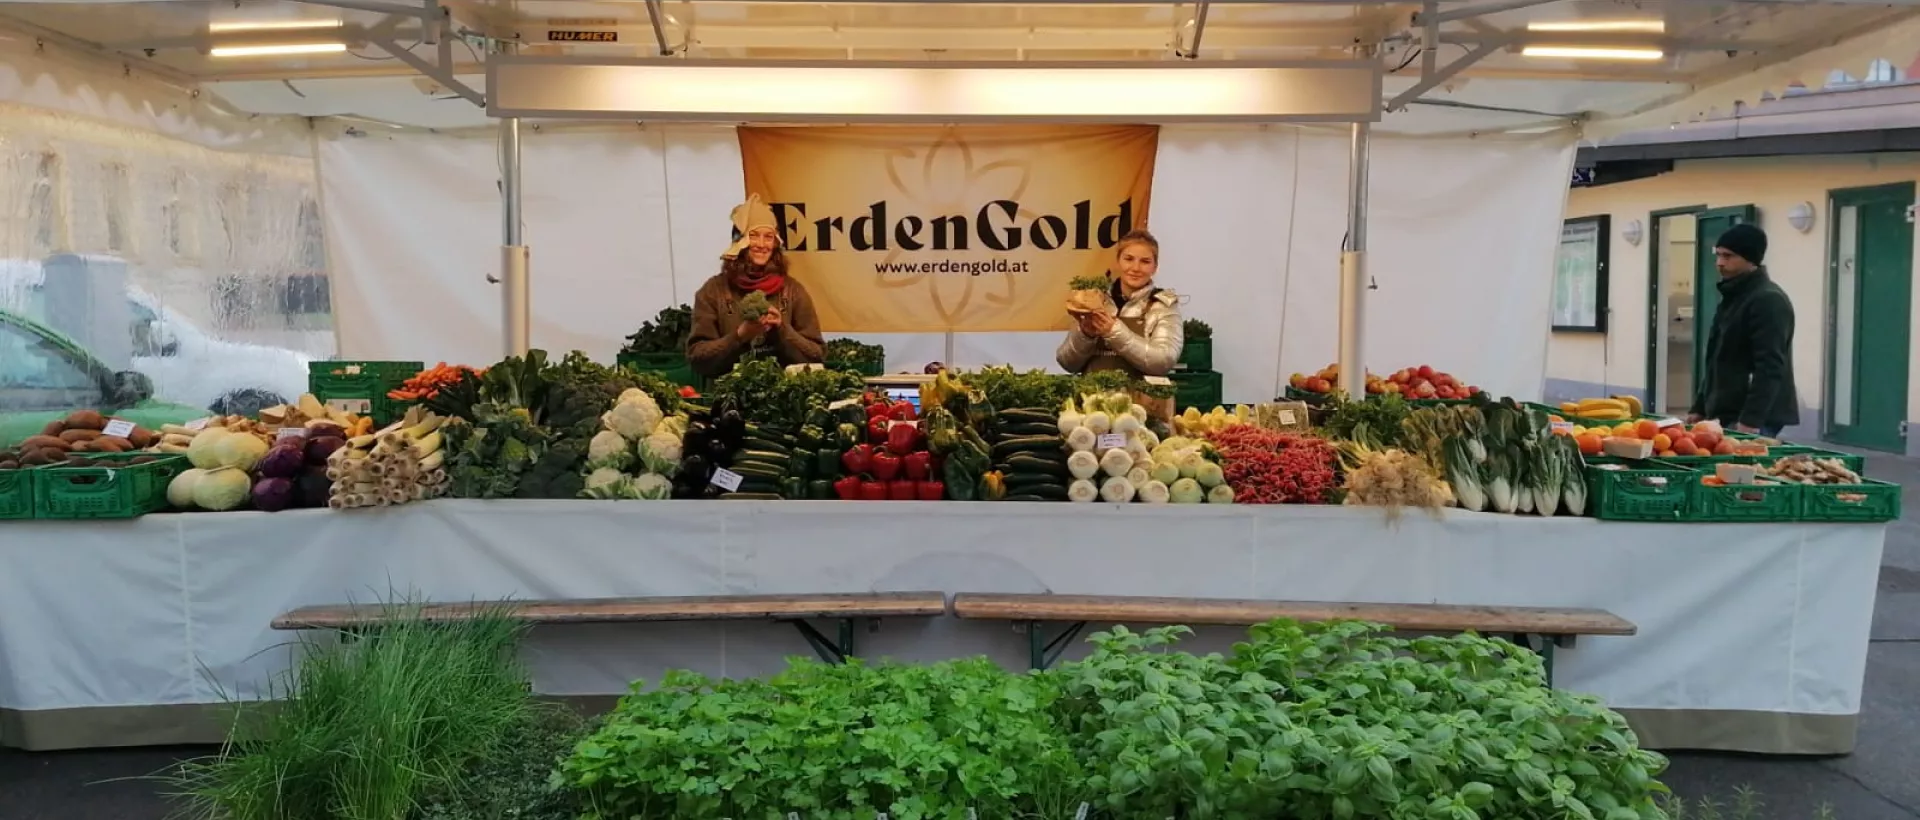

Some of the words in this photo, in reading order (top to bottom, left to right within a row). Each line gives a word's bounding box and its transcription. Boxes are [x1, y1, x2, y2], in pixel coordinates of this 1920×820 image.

[551, 32, 614, 40] HUMER
[769, 197, 1132, 251] ErdenGold
[875, 259, 1029, 276] www.erdengold.at
